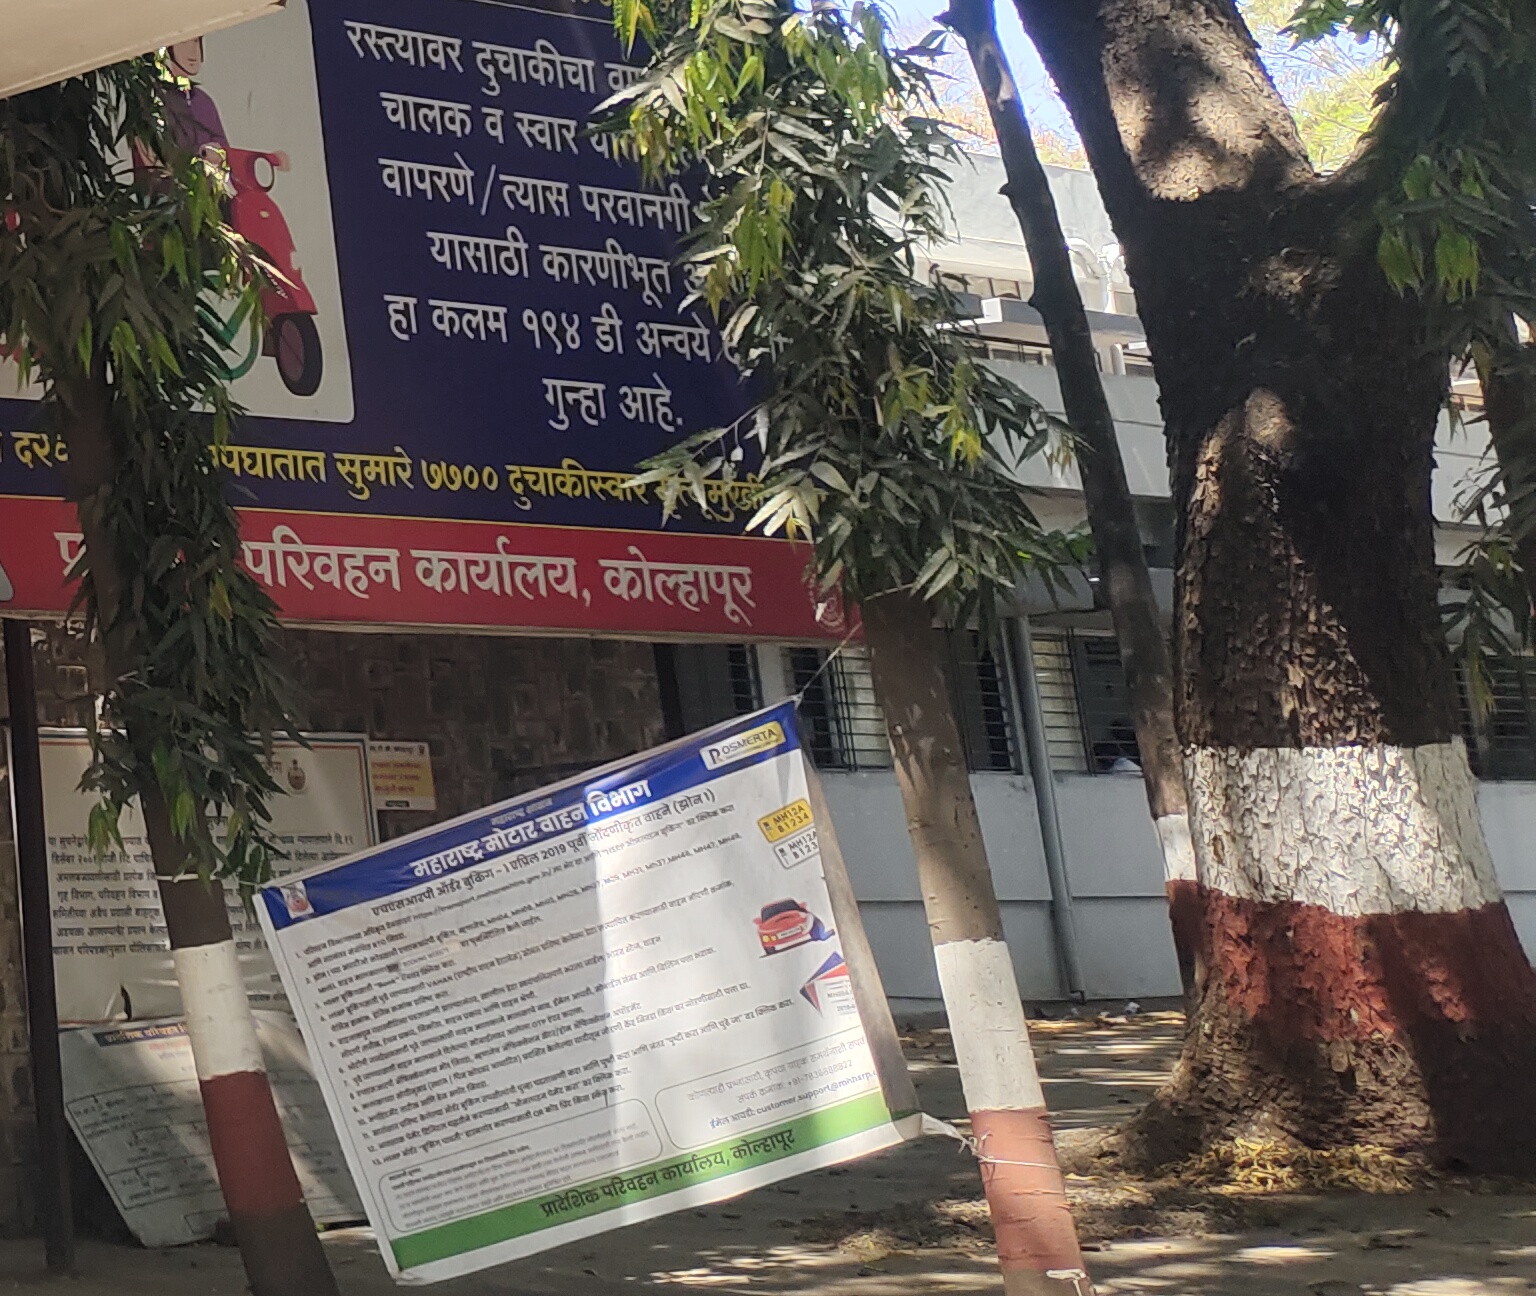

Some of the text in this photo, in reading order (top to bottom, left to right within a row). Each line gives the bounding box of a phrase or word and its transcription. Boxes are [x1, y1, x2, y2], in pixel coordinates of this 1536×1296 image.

[344, 19, 464, 75] रस्त्यावर
[471, 38, 596, 96] दुचाकीचा
[379, 92, 472, 138] चालक
[481, 107, 504, 145] व
[513, 110, 579, 155] स्वार
[579, 182, 691, 234] परवानगी
[427, 225, 529, 279] यासाठी
[538, 237, 672, 309] कारणीभूत
[383, 292, 419, 341] हा
[429, 298, 508, 344] कलम
[522, 308, 582, 355] १९४
[590, 302, 624, 354] डी
[636, 312, 711, 364] अन्वये
[541, 372, 684, 433] गुन्हा आहे.
[209, 444, 327, 485] पघातात
[335, 445, 414, 500] सुमारे
[421, 460, 499, 493] ७७००
[506, 458, 650, 510] दुचाकीस्वार
[241, 525, 758, 627] परिवहन कार्यालय, कोल्हापूर
[409, 836, 485, 880] महाराष्ट्र
[481, 816, 540, 853] मोटार
[535, 802, 589, 835] वाहन
[588, 778, 653, 818] विभाग
[434, 876, 462, 896] ऑर्डर
[461, 865, 496, 891] बुकिंग
[540, 842, 567, 860] 2019
[642, 802, 672, 823] वाहने
[793, 841, 819, 860] B123
[538, 1123, 798, 1219] प्रादेशिक परिवहन कार्यालय, कोल्हापूर
